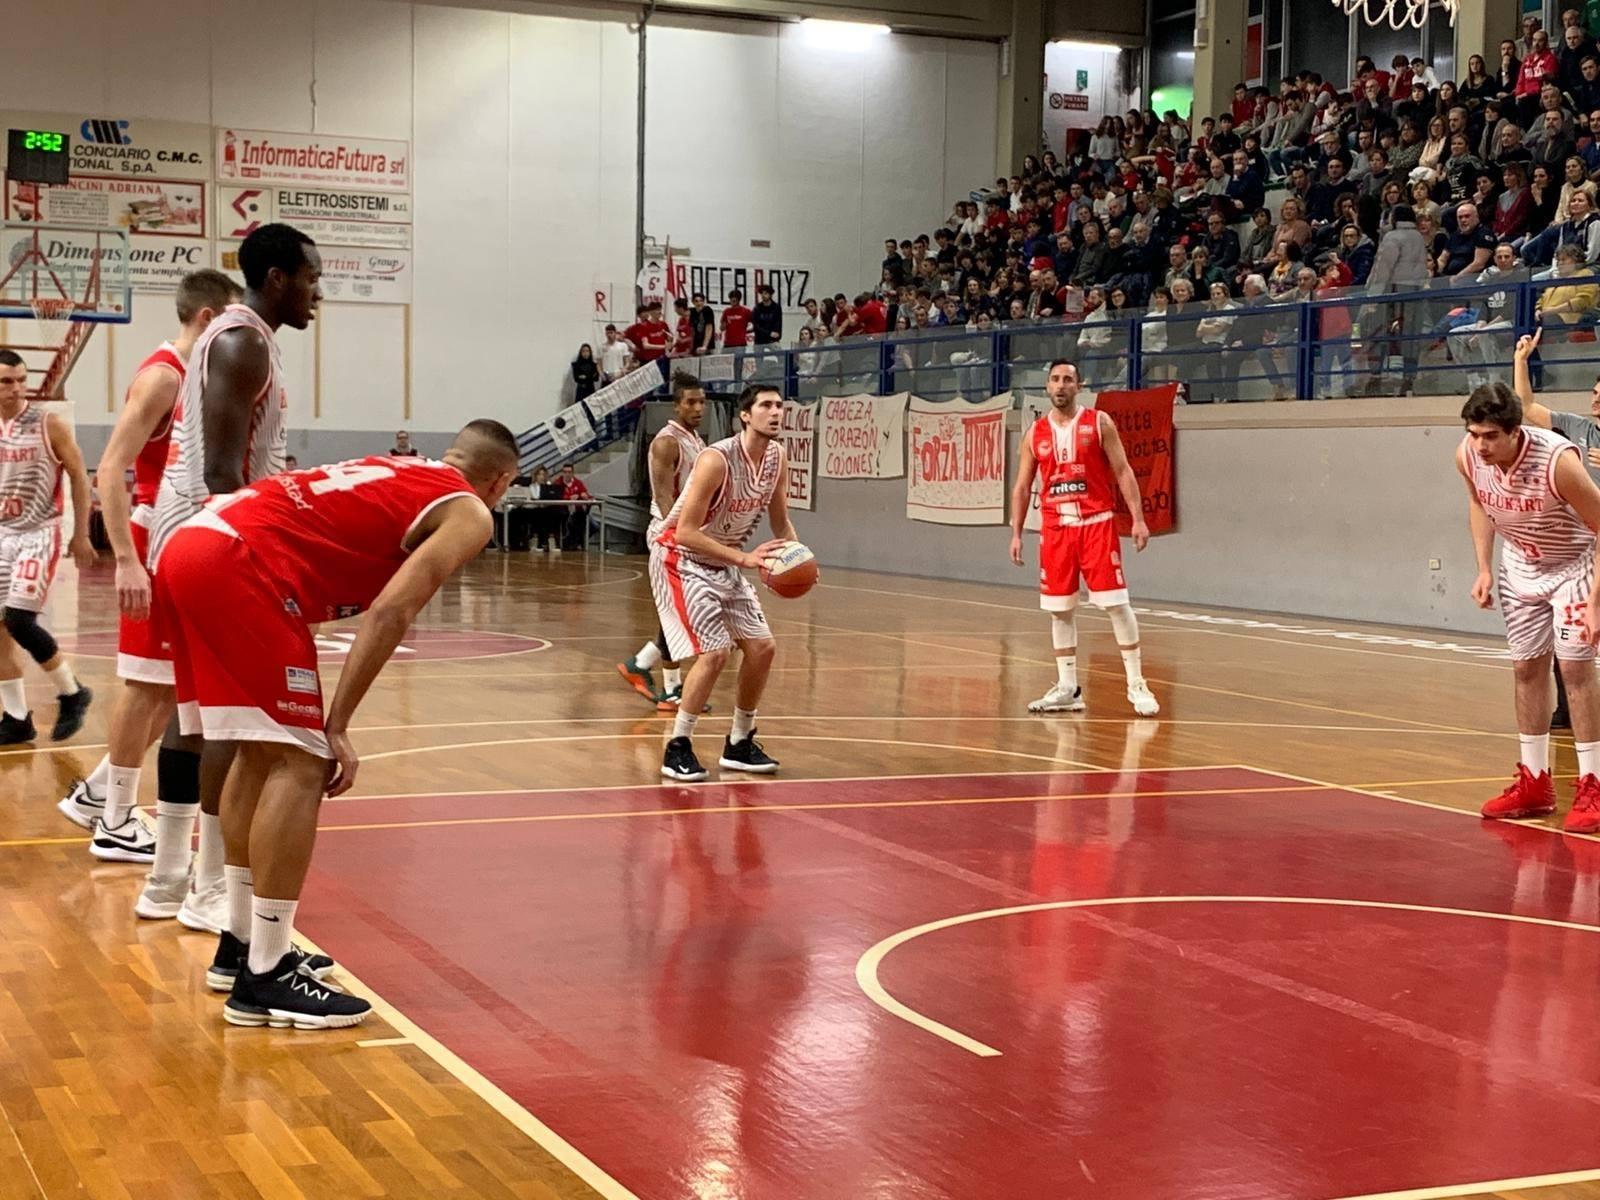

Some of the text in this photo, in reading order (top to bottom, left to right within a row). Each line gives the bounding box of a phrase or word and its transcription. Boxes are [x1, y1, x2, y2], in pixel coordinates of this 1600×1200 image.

[25, 131, 63, 152] 2:52
[74, 144, 203, 164] CONCIARIO C.M.C.
[241, 140, 405, 175] InformaticaFutura srl
[108, 183, 162, 194] ADRIANA
[278, 191, 389, 211] ELETTROSISTEMI
[279, 207, 380, 220] AUTOMAZIONI INDUSTRIALI
[170, 246, 203, 264] PC
[1479, 489, 1545, 512] BLUKART
[16, 559, 40, 581] 10
